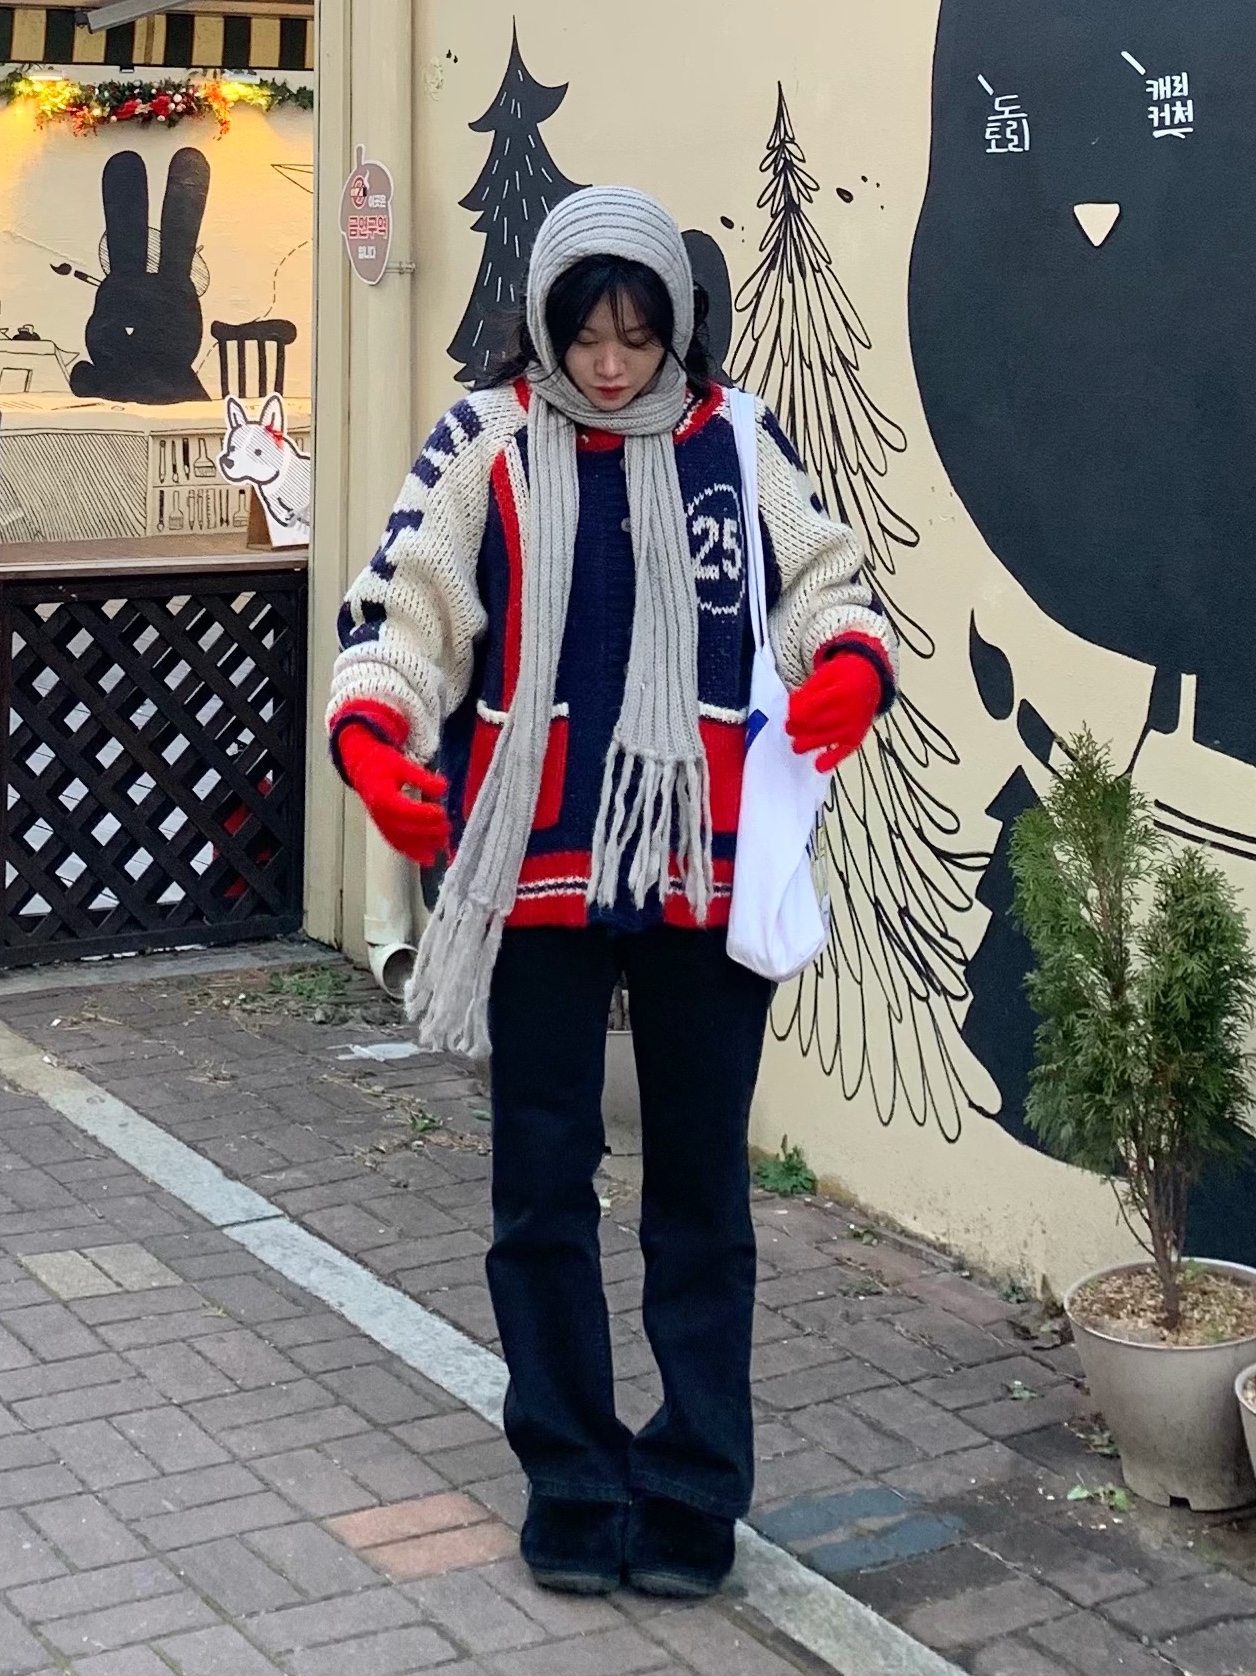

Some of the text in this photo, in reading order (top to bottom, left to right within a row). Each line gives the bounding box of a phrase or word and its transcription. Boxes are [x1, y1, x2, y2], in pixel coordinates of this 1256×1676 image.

[1145, 71, 1188, 100] 캐리
[987, 94, 1028, 120] 도
[985, 118, 1030, 153] 토리
[348, 215, 388, 240] 금연구역
[691, 514, 742, 580] 25
